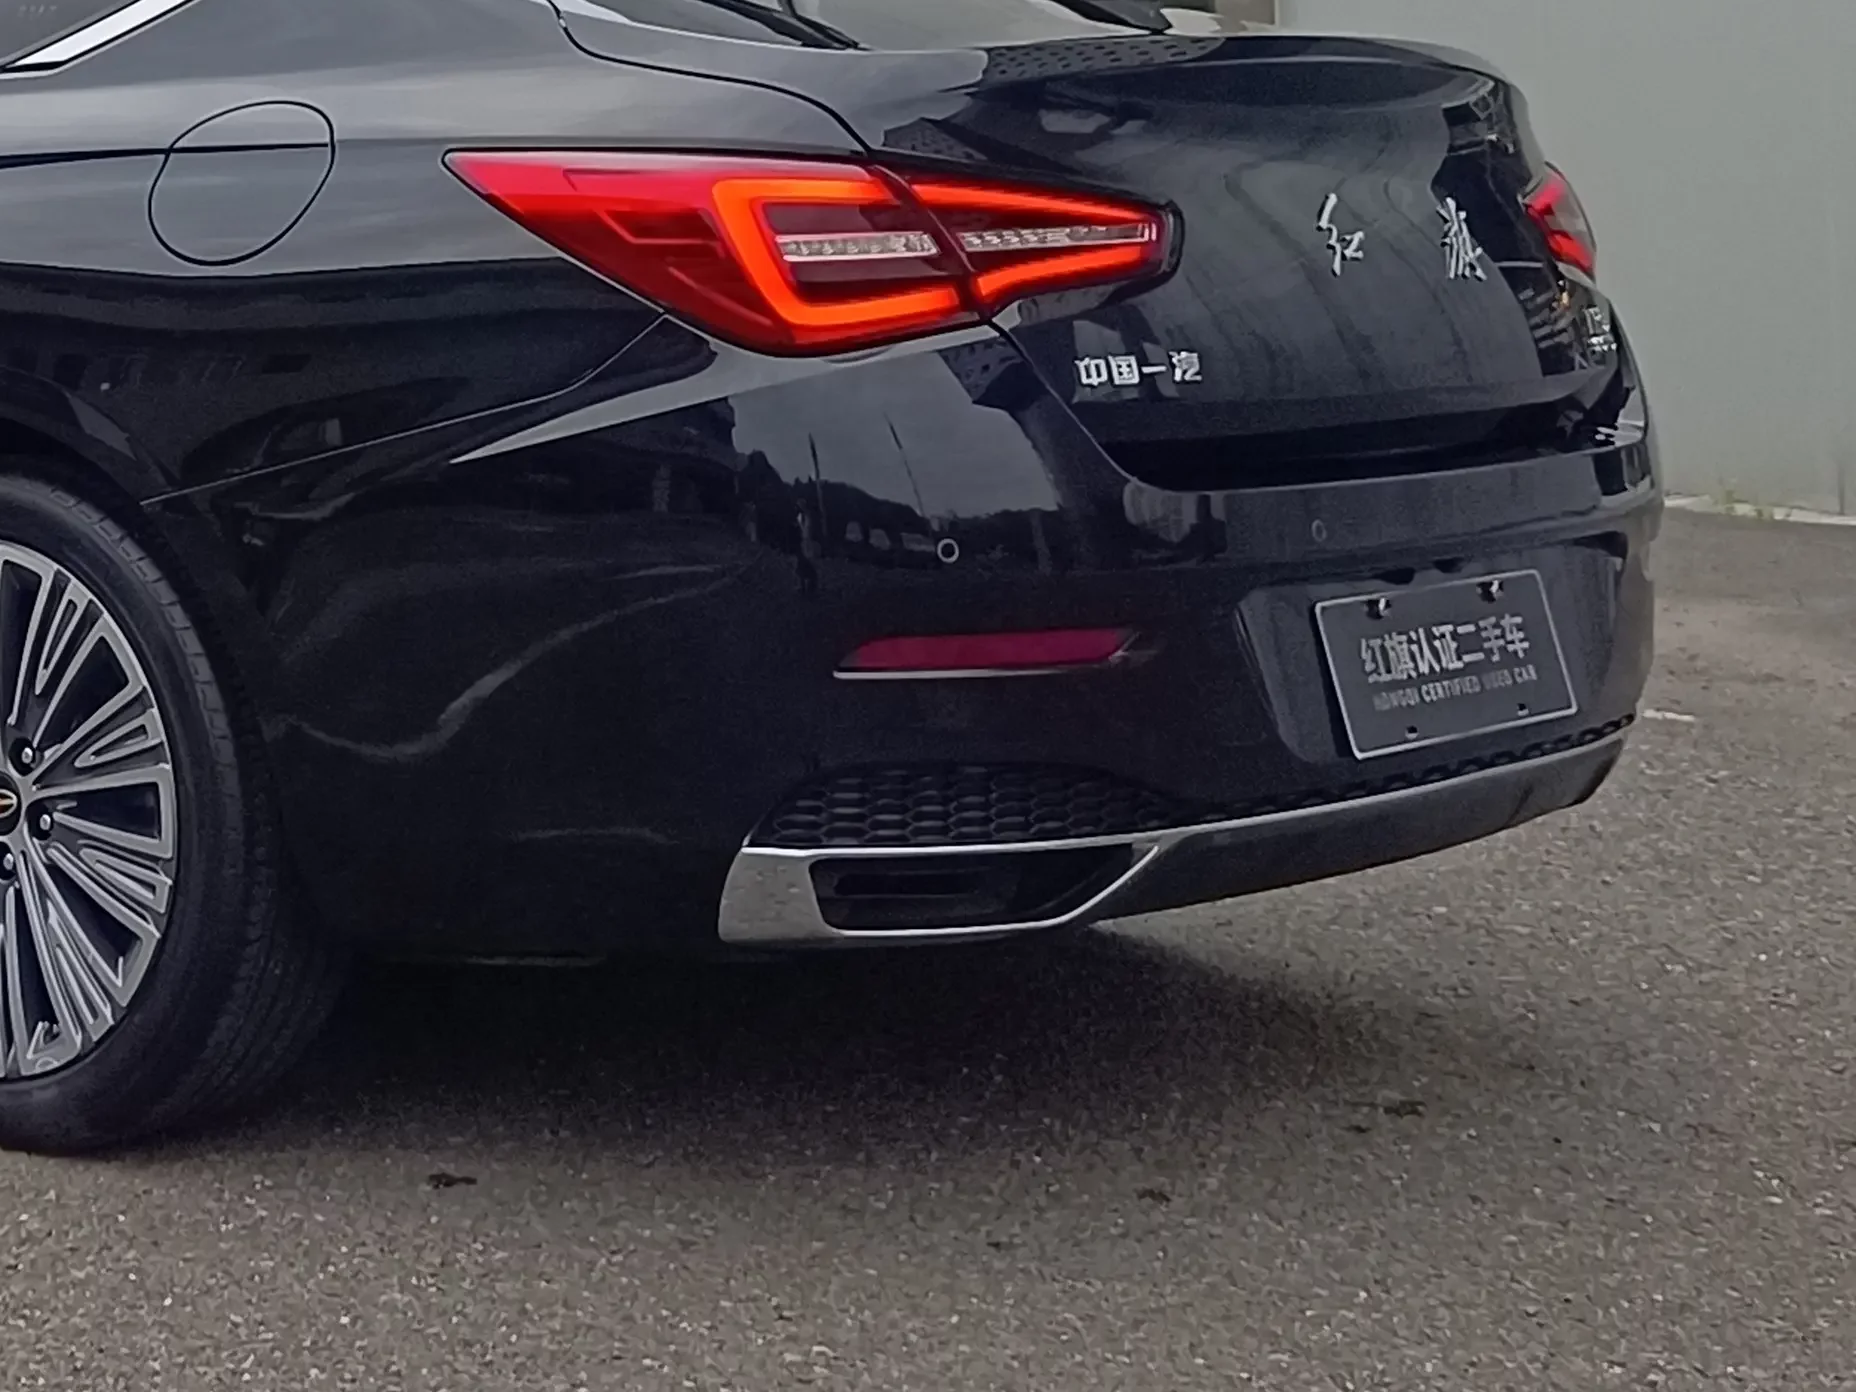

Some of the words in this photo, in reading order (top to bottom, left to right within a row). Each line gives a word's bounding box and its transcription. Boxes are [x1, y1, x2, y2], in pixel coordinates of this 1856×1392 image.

[1074, 351, 1203, 386] 中国一汽
[1360, 613, 1530, 684] 红旗认证二手车
